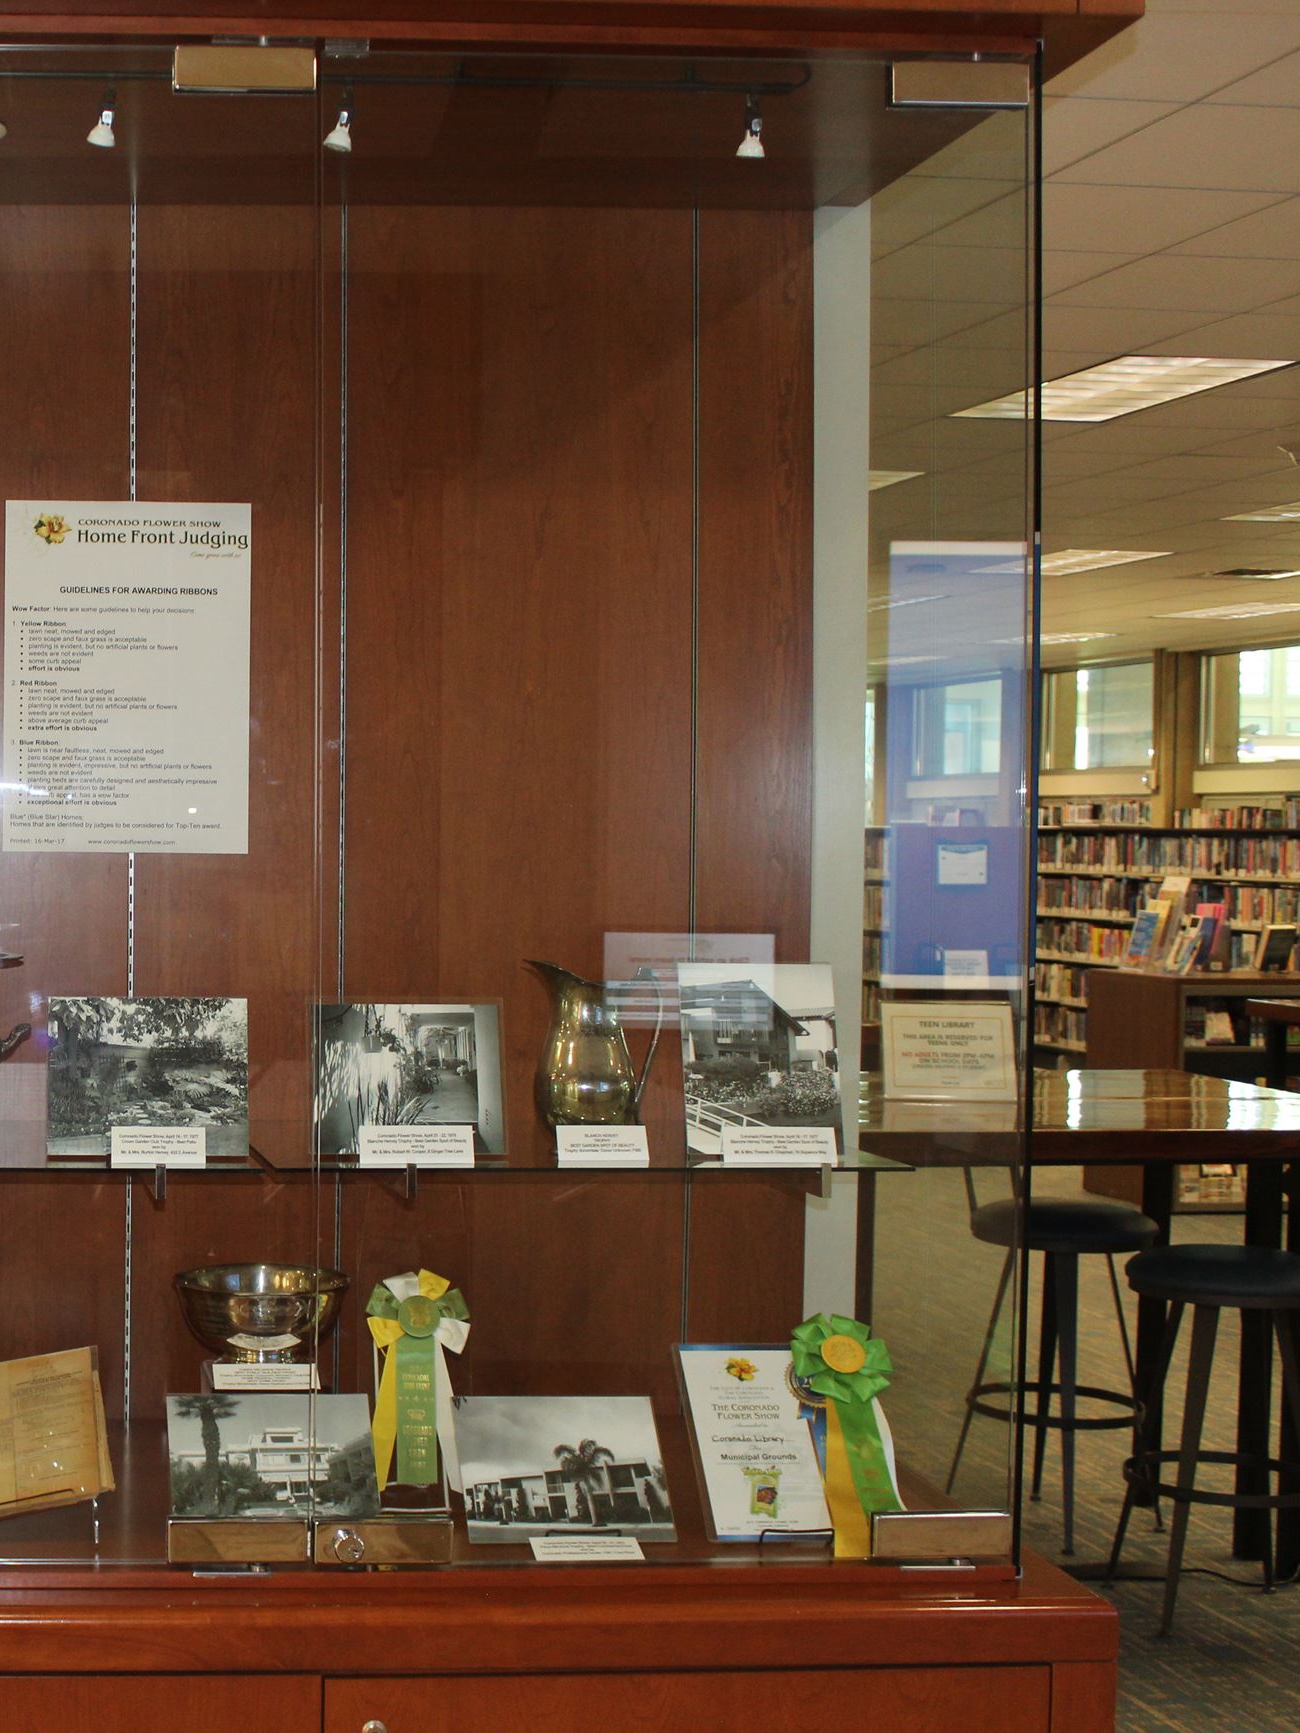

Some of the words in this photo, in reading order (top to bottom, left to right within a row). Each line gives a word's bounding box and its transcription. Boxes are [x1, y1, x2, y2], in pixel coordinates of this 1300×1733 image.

[78, 530, 126, 543] Home
[131, 530, 175, 544] Front
[180, 531, 248, 549] Judging
